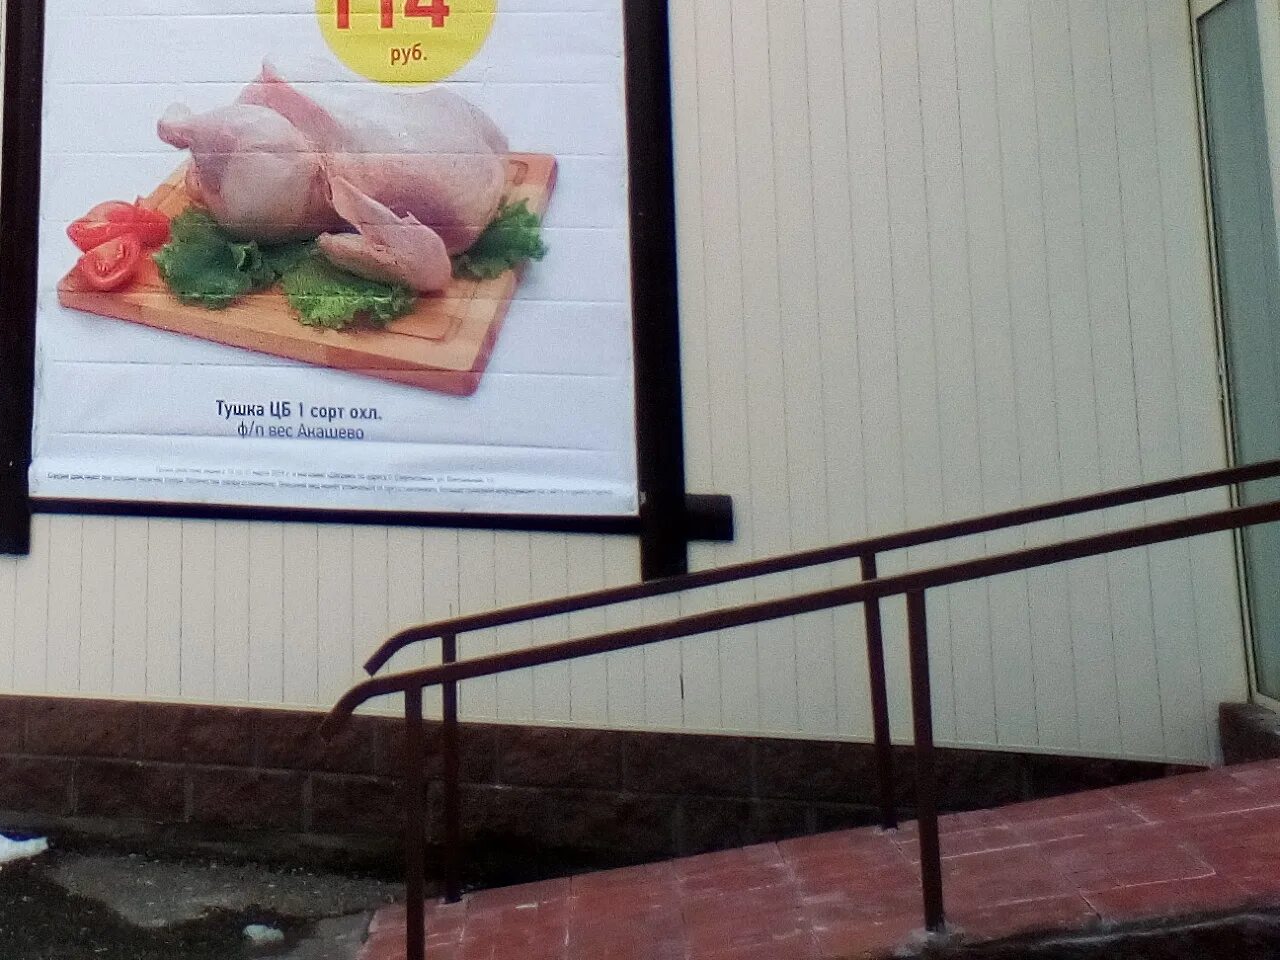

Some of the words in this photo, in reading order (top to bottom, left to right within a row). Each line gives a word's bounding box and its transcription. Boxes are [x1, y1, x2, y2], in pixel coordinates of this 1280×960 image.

[390, 43, 428, 66] руб.
[216, 400, 265, 419] Тушка
[270, 401, 291, 420] ЦБ
[310, 406, 345, 422] сорт
[350, 407, 383, 420] охл.
[237, 421, 264, 439] ф/п
[269, 425, 293, 438] вес
